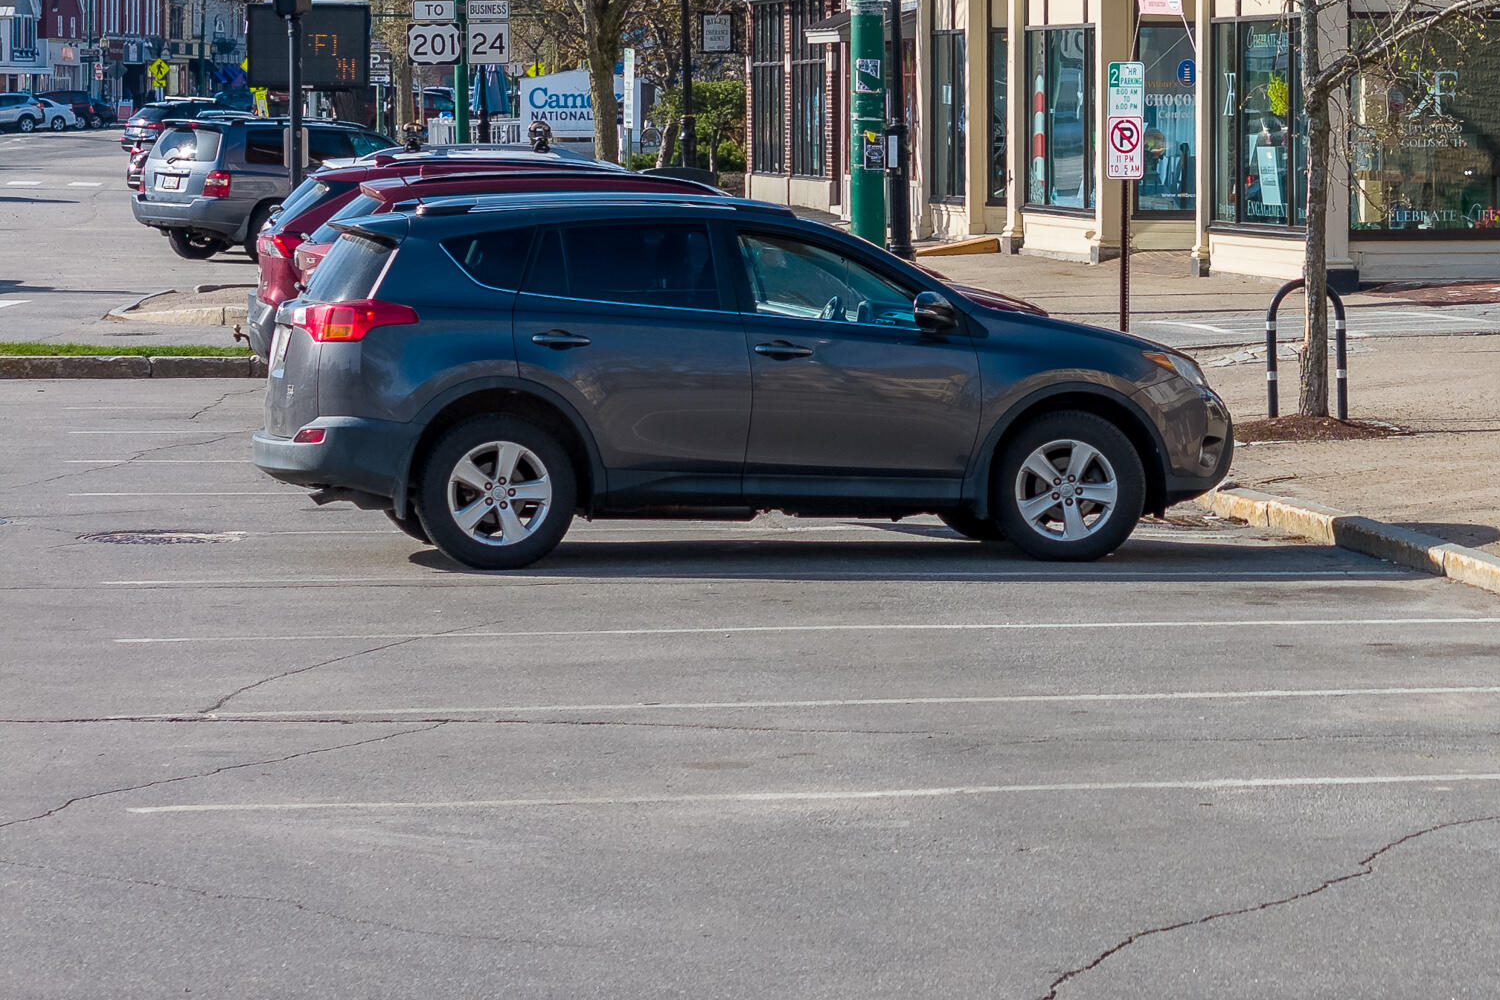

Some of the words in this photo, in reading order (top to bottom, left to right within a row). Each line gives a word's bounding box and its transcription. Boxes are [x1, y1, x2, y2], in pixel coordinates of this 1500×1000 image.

[424, 4, 445, 17] TO
[469, 3, 508, 16] BUSINESS
[413, 33, 457, 57] 201
[471, 32, 506, 56] 24
[1110, 68, 1119, 84] 2
[1128, 67, 1138, 76] HR
[1120, 77, 1142, 86] PARKING
[528, 86, 592, 109] Cam
[530, 110, 594, 122] NATIONAL
[1124, 155, 1135, 163] PM
[1110, 164, 1120, 173] TO
[1130, 163, 1140, 172] AM
